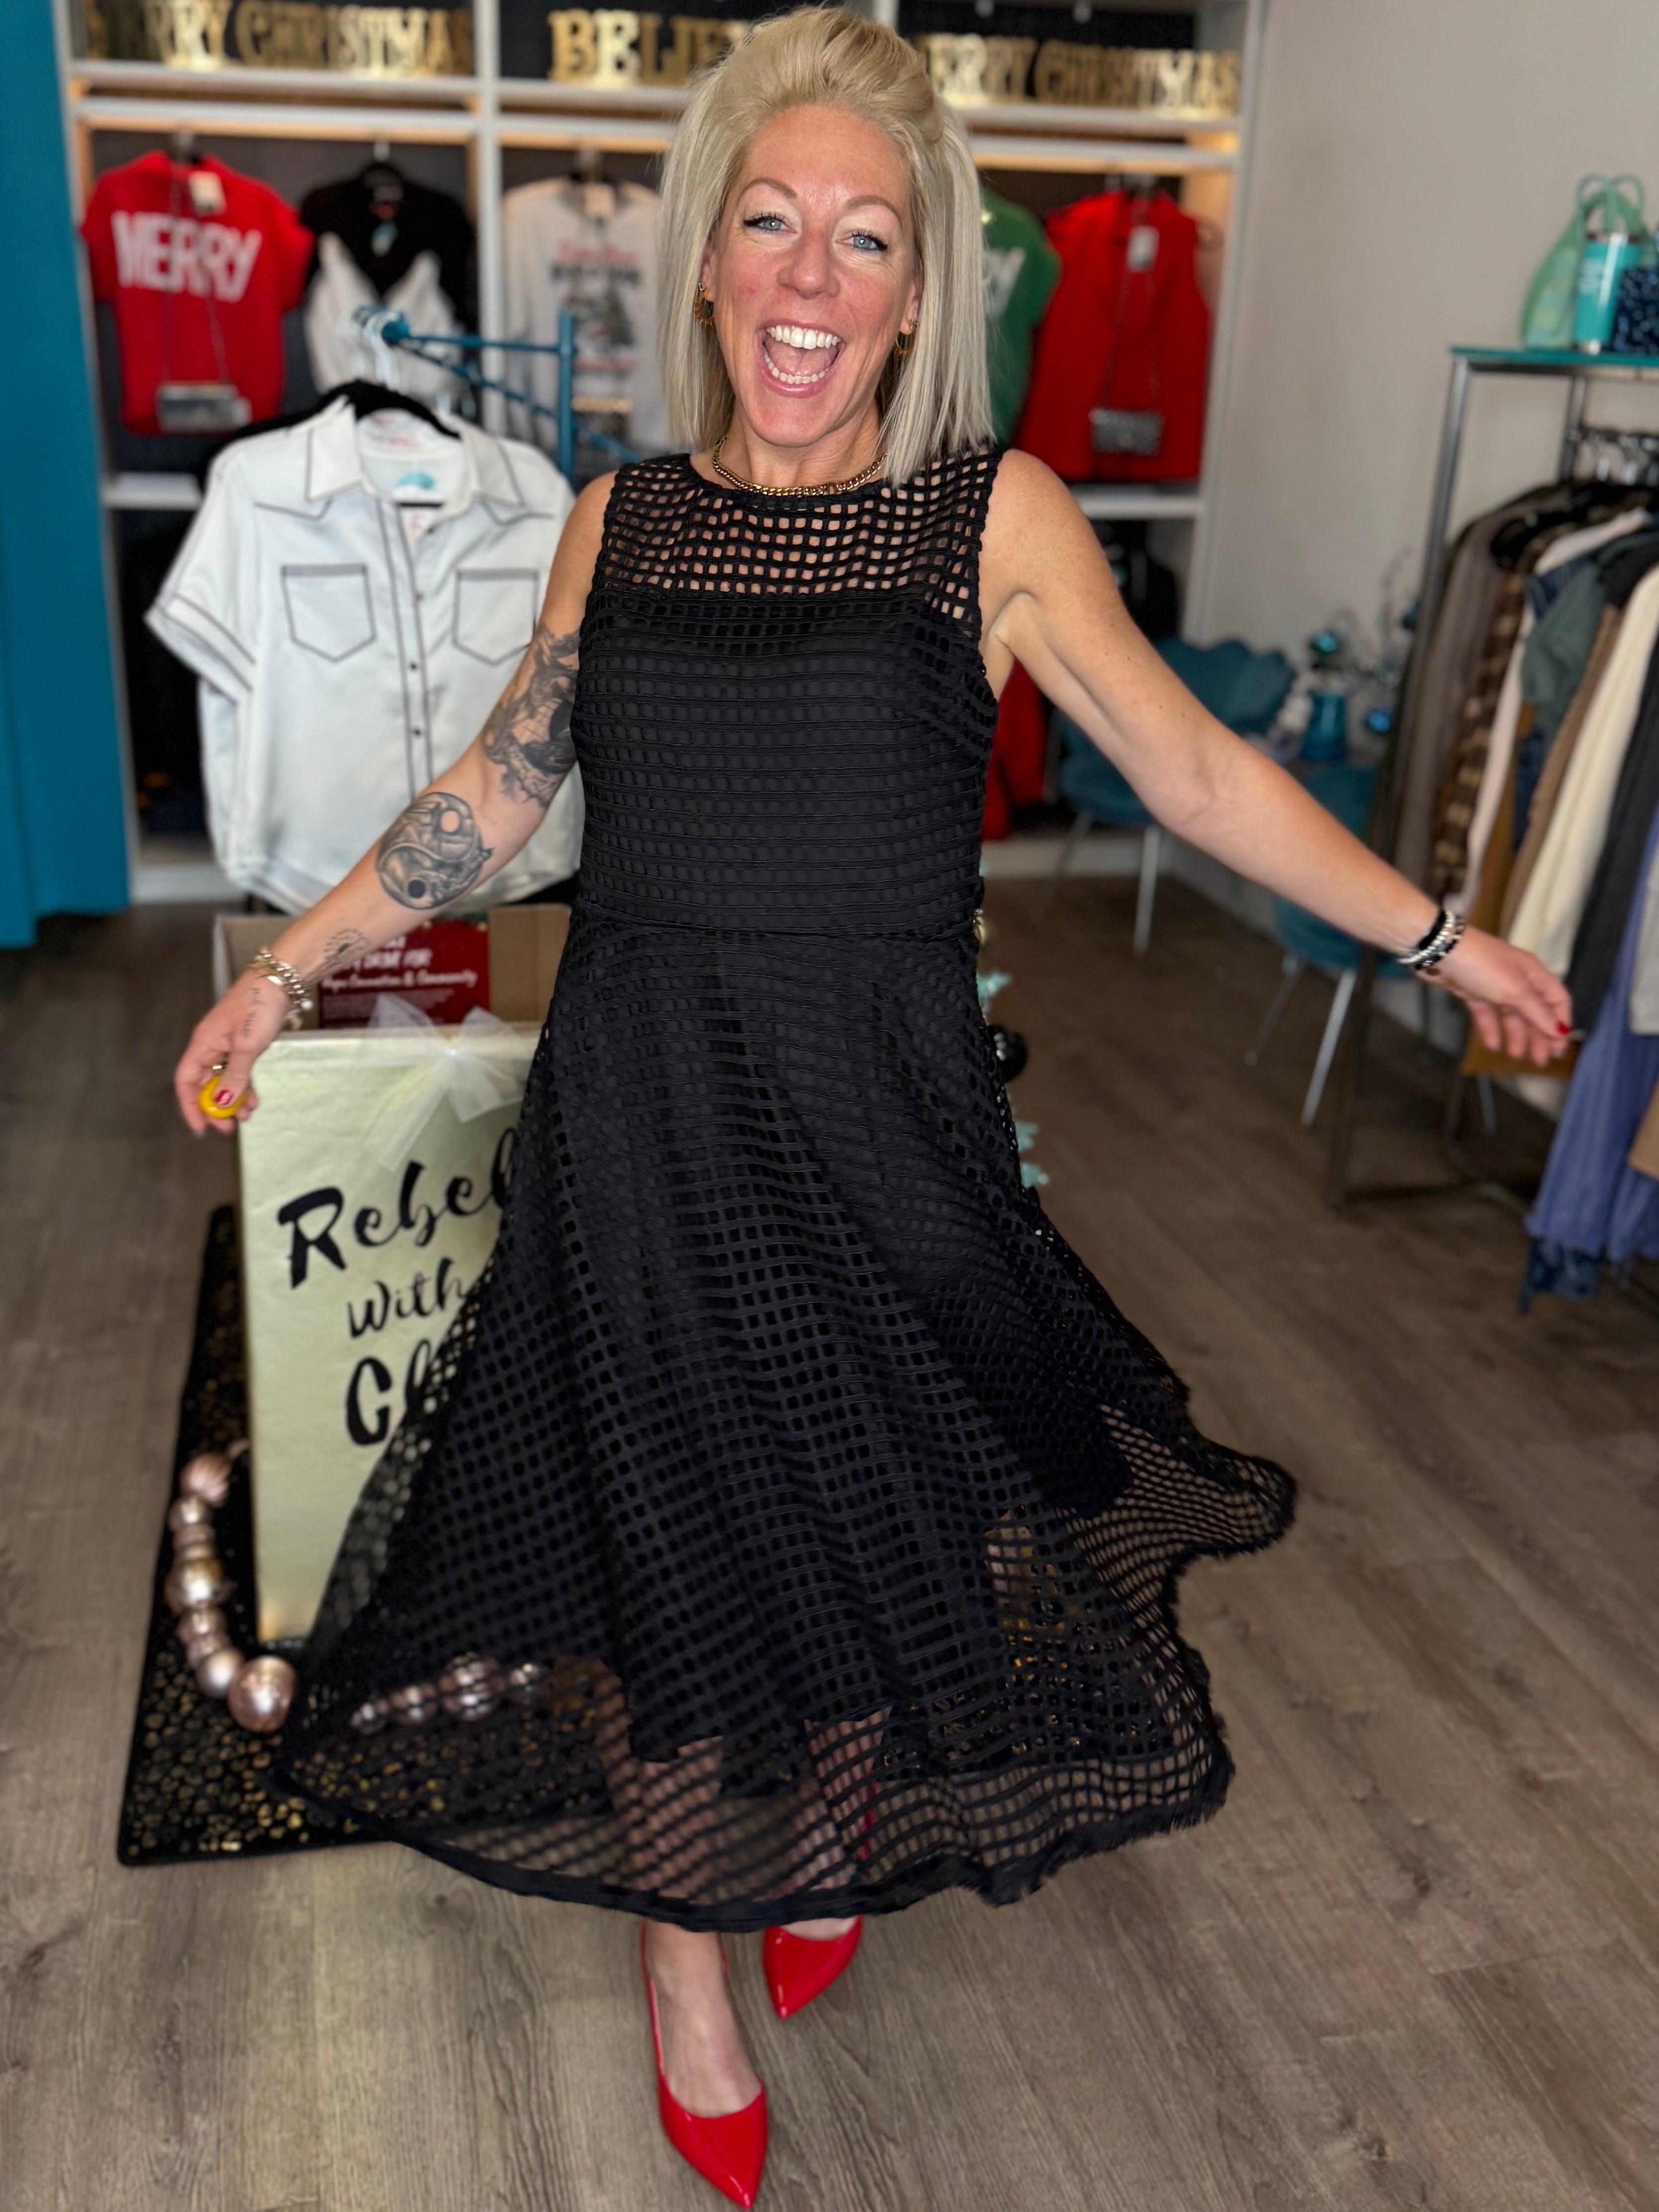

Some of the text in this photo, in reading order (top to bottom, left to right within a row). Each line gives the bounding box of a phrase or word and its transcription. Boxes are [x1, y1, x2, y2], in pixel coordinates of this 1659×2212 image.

[111, 210, 262, 303] MERRY
[277, 1128, 514, 1289] Rebel
[347, 1256, 467, 1338] with
